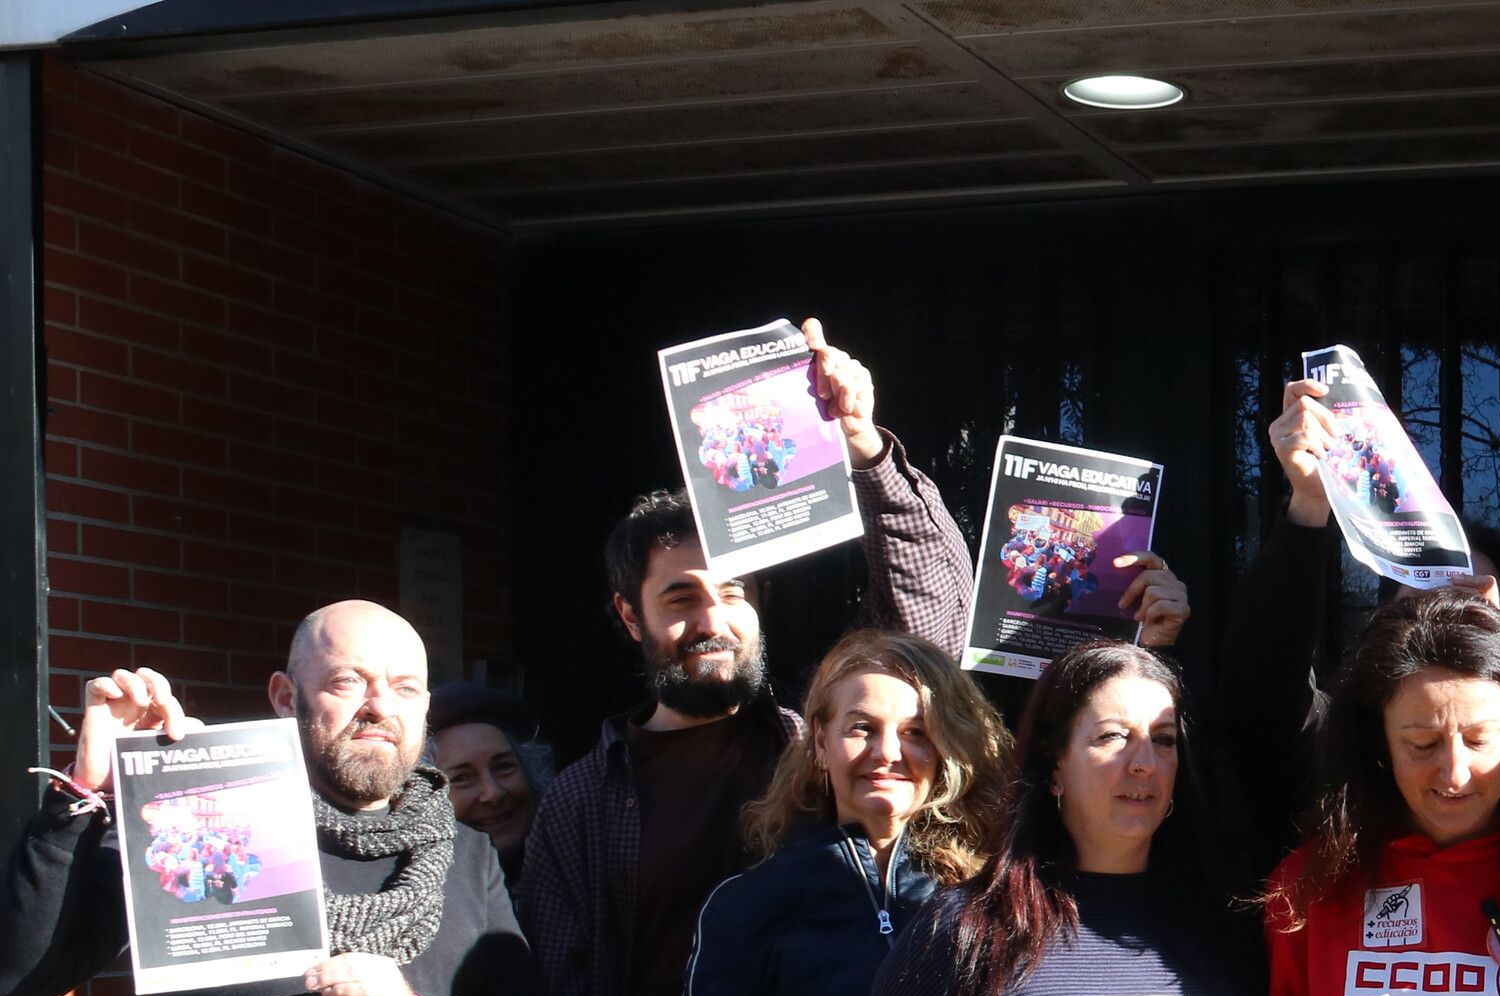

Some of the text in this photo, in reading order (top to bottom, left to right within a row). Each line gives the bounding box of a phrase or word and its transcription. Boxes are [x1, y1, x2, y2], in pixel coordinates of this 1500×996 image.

[669, 359, 701, 387] 11F
[700, 349, 740, 370] VAGA
[740, 333, 808, 359] EDUCATIV
[1004, 453, 1038, 480] 11F
[1038, 461, 1080, 481] VAGA
[1081, 468, 1152, 494] EDUCATIVA
[1414, 570, 1430, 579] CGT
[121, 751, 161, 776] 11F
[161, 748, 210, 765] VAGA
[1375, 925, 1418, 939] educació
[1377, 917, 1418, 928] recursos
[1355, 961, 1486, 993] CCOO
